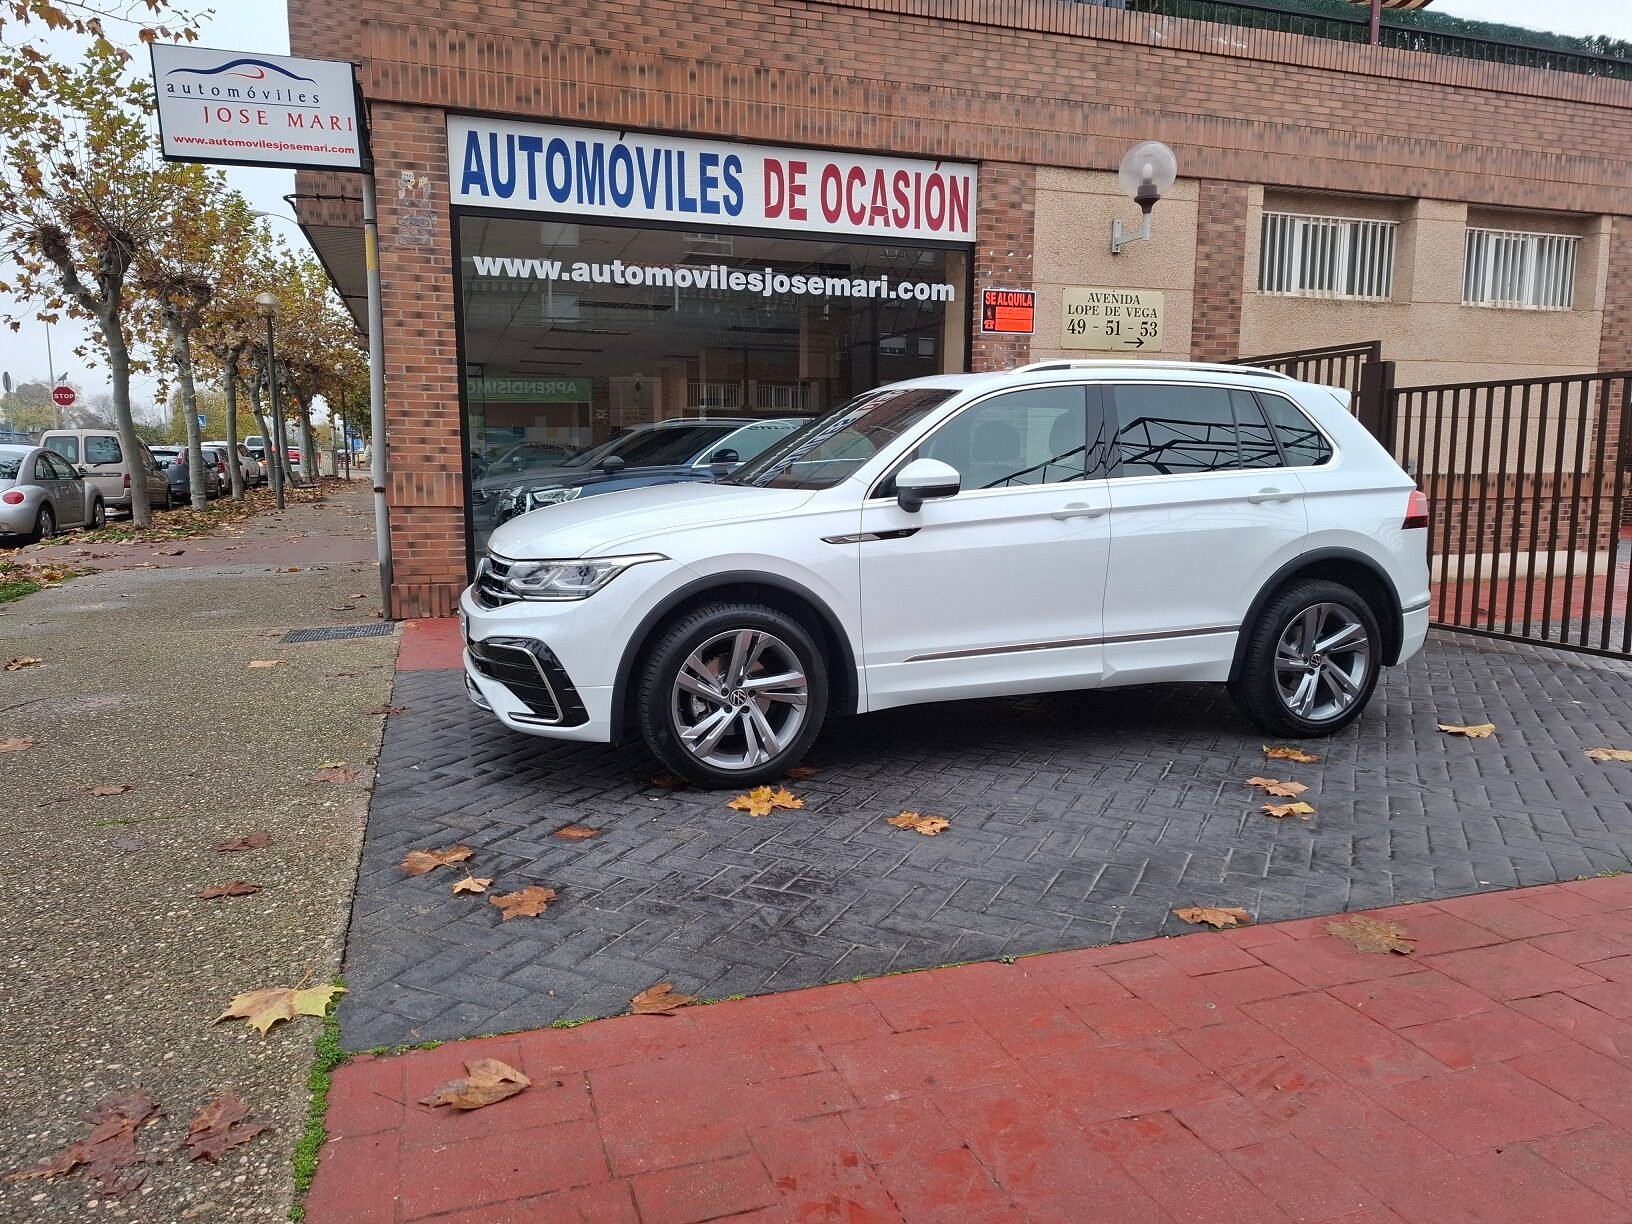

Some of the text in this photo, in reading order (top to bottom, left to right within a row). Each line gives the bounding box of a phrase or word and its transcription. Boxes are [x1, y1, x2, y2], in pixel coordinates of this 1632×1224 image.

[167, 83, 320, 104] automóviles
[203, 106, 353, 132] JOSE MARI
[173, 135, 355, 155] www.automovilesjosemari.com
[461, 129, 970, 233] AUTOMÓVILES DE OCASIÓN
[473, 255, 955, 302] www.automovilesjosemari.com
[985, 291, 1033, 307] SE ALQUILA
[1087, 292, 1141, 305] AVENIDA
[1067, 304, 1158, 318] LOPE DE VEGA
[1067, 318, 1086, 335] 49
[1105, 319, 1121, 336] 51
[1140, 321, 1158, 337] 53
